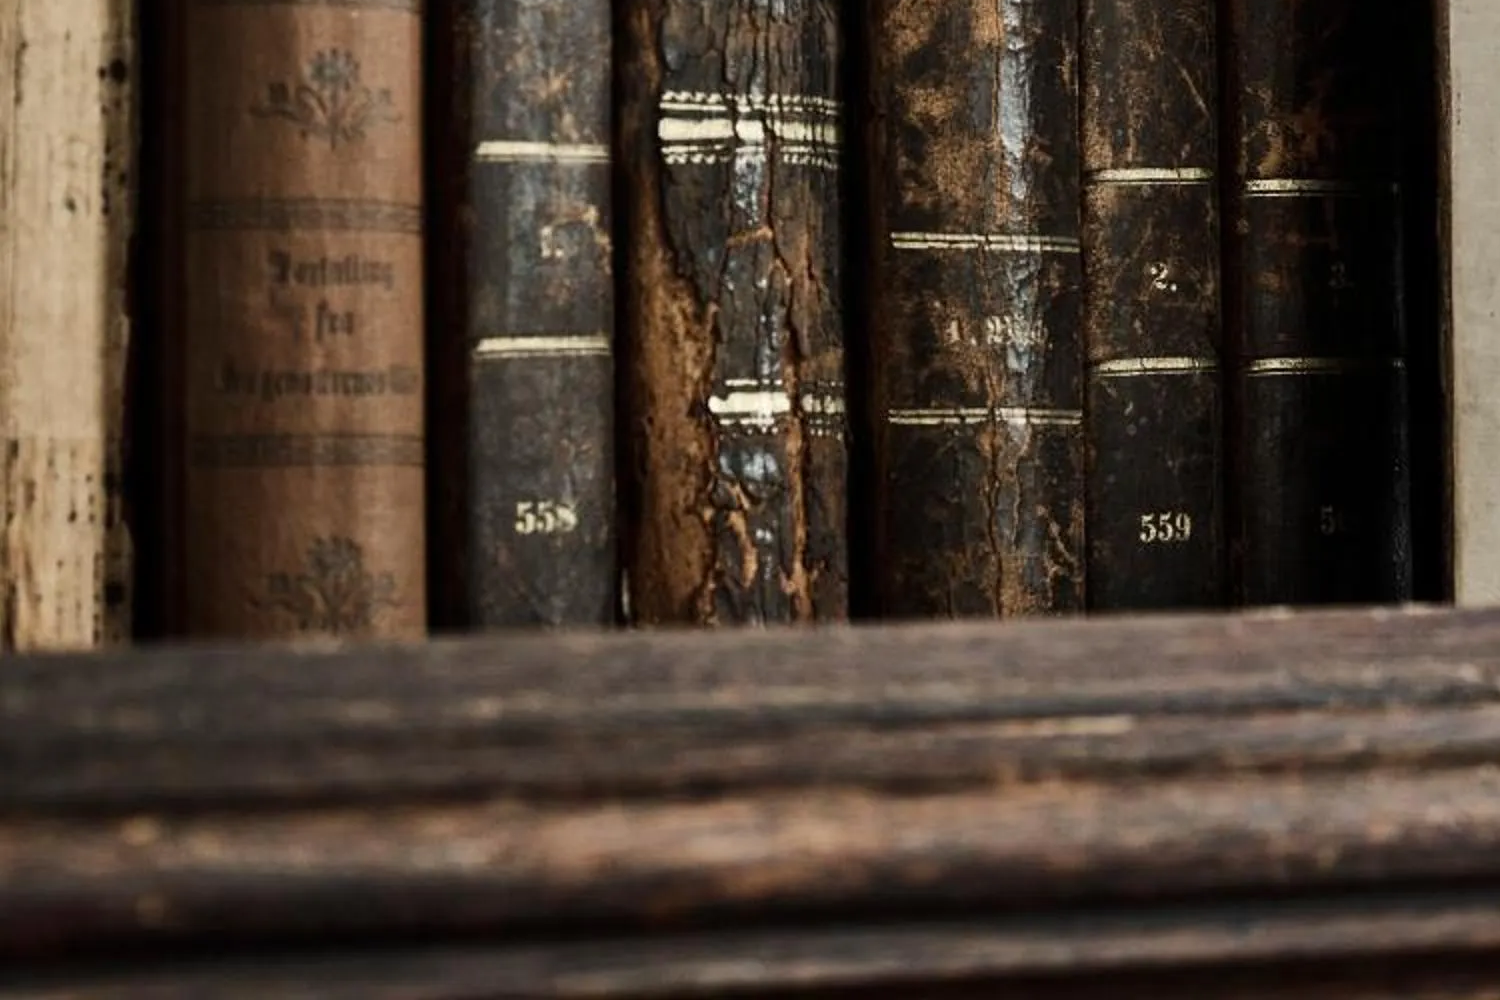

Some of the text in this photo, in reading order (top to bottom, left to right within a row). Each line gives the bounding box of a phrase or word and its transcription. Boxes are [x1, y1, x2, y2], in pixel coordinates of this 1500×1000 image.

[1150, 261, 1178, 293] 2.
[514, 500, 578, 536] 558
[1139, 510, 1192, 543] 559
